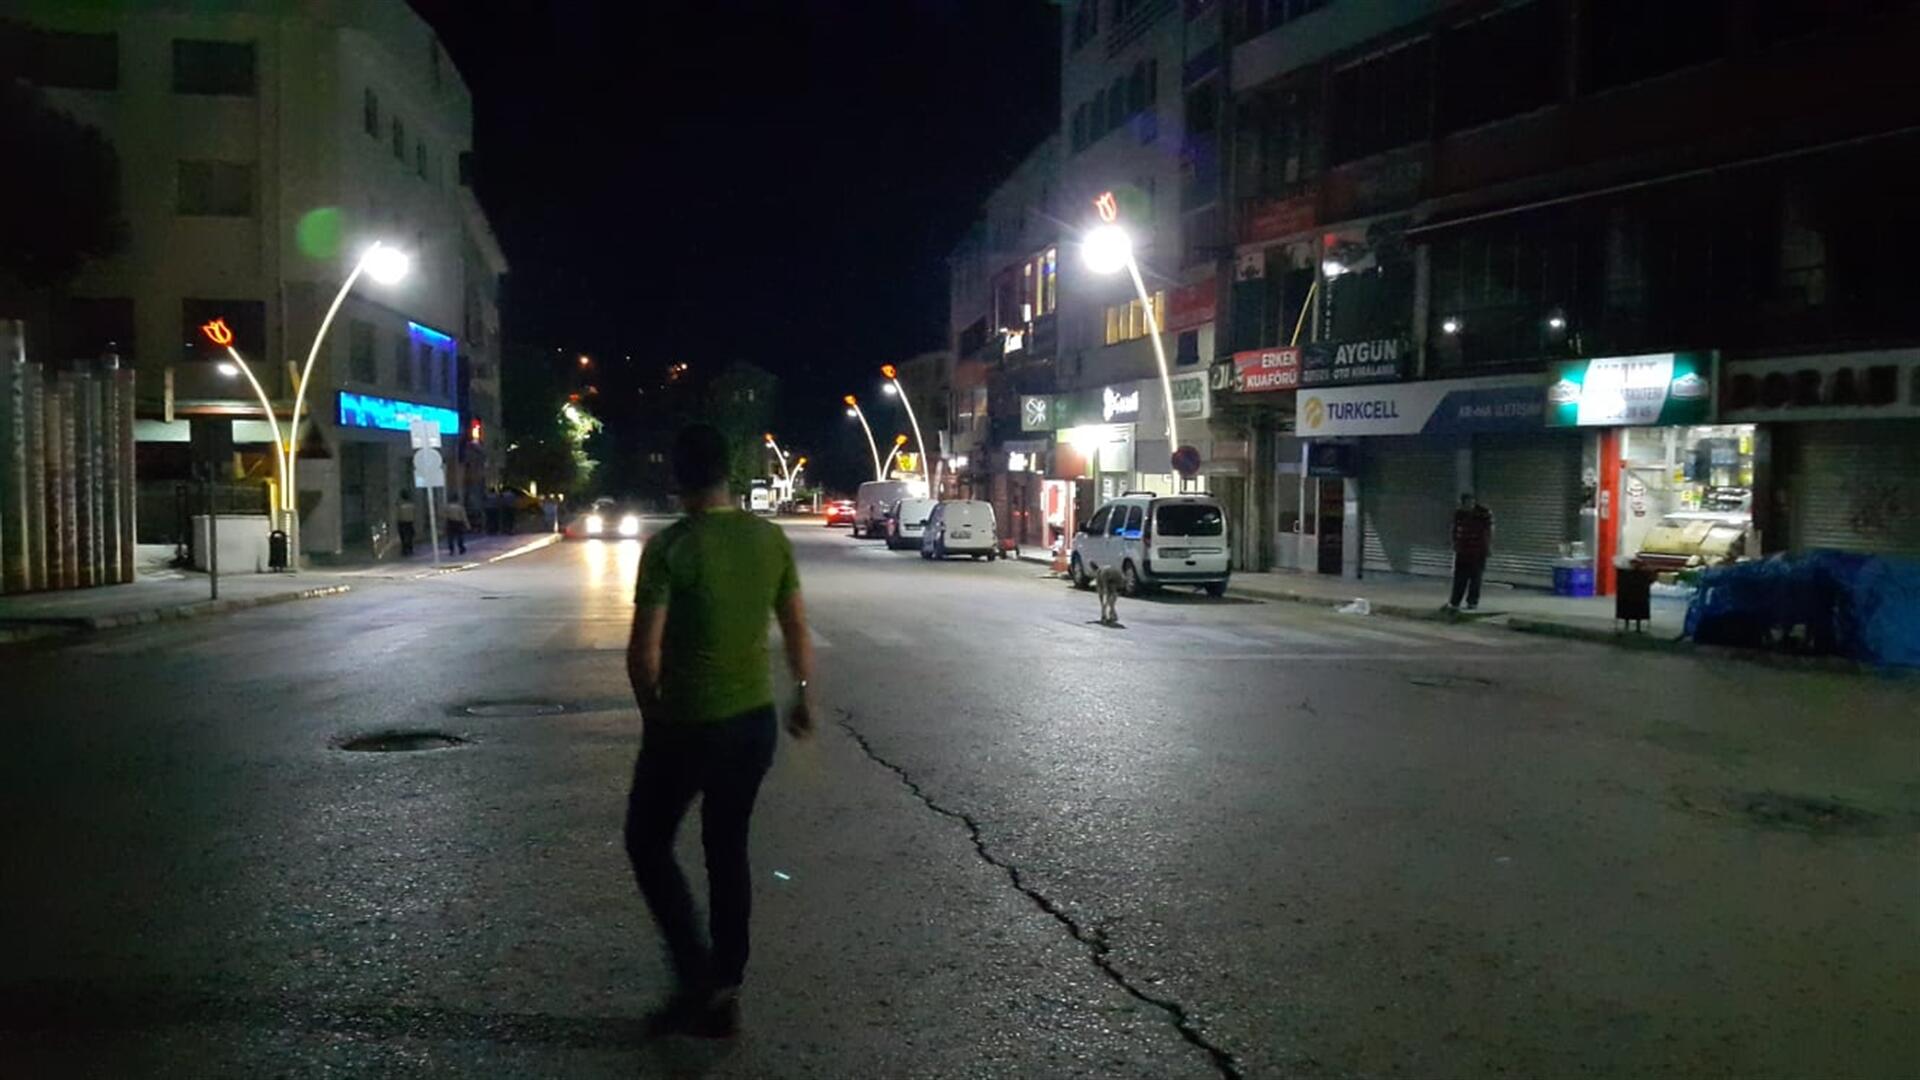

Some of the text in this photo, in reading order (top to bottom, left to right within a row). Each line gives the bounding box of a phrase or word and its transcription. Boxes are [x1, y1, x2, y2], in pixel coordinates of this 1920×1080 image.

[1261, 351, 1297, 369] ERKEK
[1335, 339, 1397, 365] AYGÜN
[1246, 370, 1297, 388] KUAFÖRÜ
[1326, 400, 1400, 420] TURKCELL
